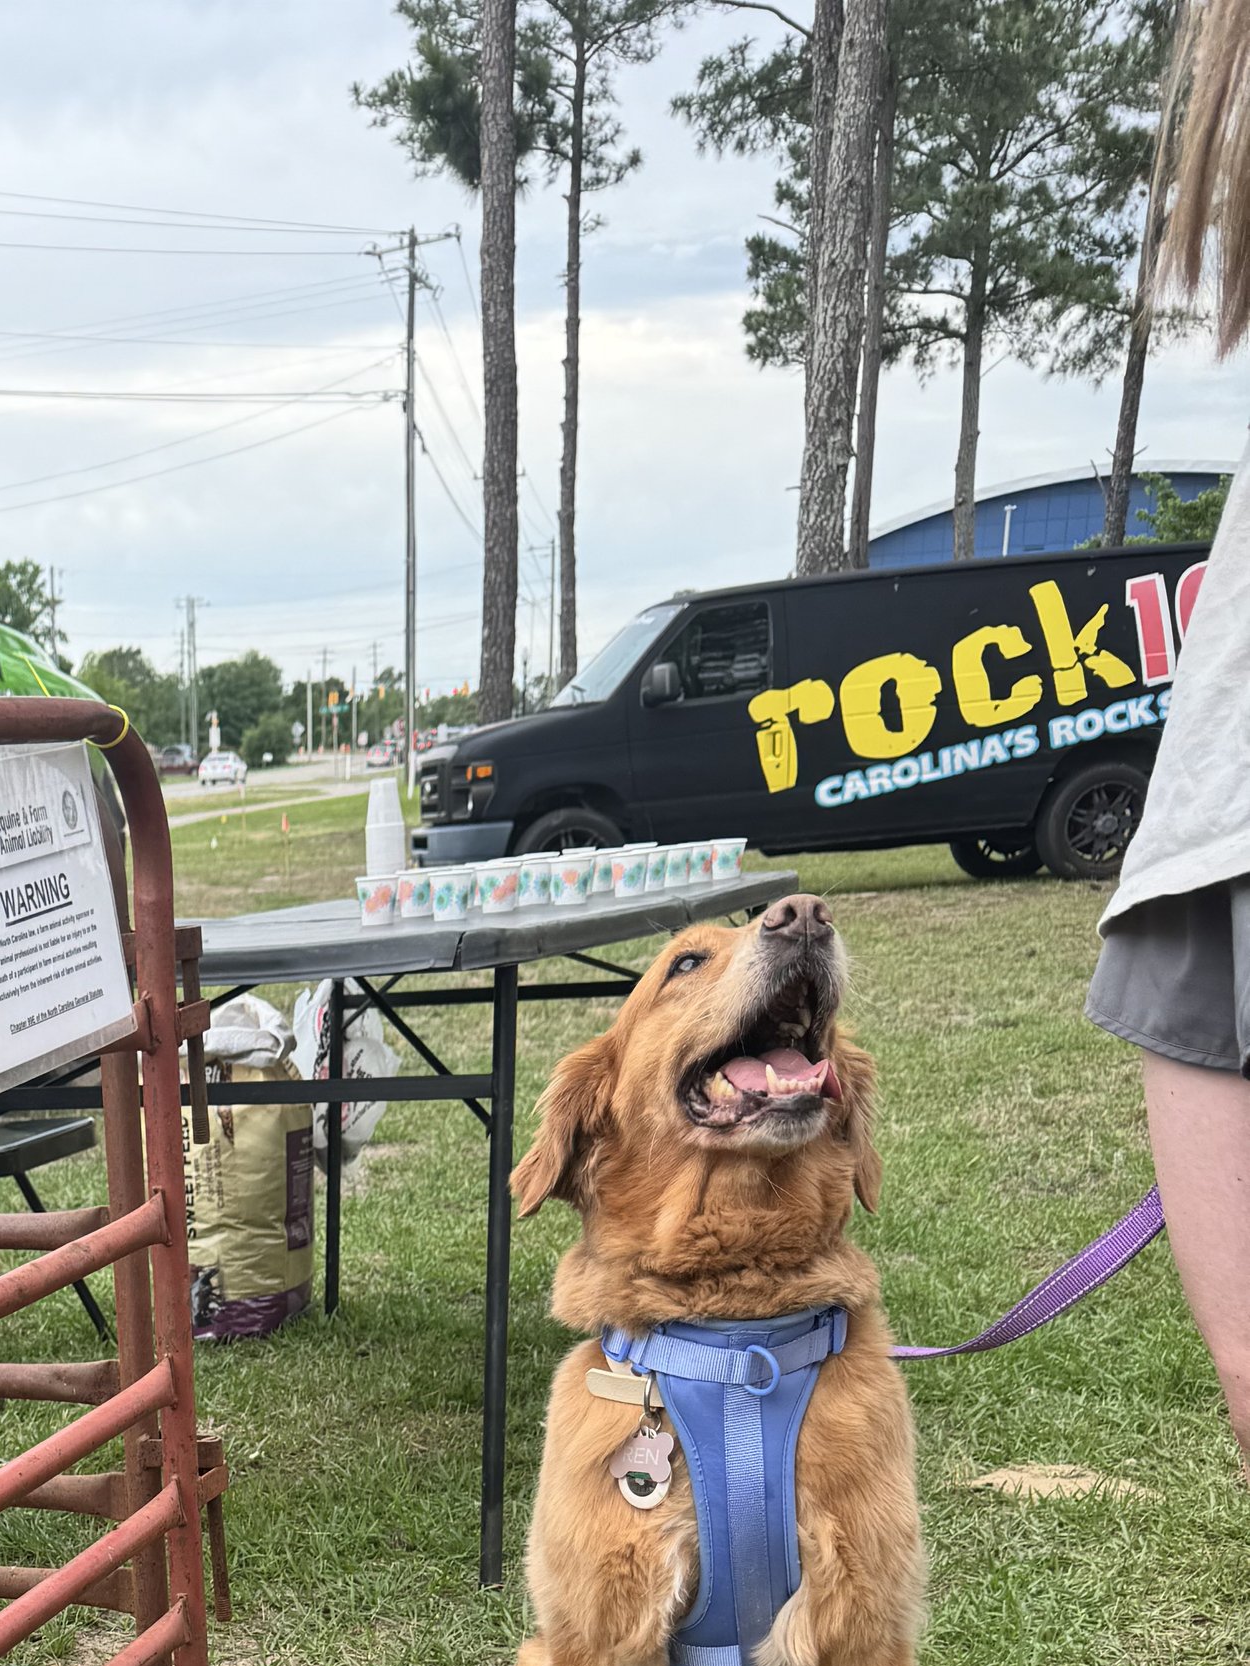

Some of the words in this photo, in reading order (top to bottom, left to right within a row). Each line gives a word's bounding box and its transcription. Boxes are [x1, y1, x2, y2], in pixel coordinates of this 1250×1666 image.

[748, 580, 1136, 793] rock
[815, 724, 1040, 807] CAROLINA'S
[22, 807, 29, 824] &
[29, 805, 48, 824] Farm
[0, 830, 26, 855] Animal
[26, 824, 54, 847] Liability
[0, 873, 70, 919] WARNING
[0, 937, 11, 948] North
[11, 931, 28, 943] Carolina
[39, 924, 49, 933] farm
[49, 918, 61, 930] animal
[62, 914, 75, 926] activity
[0, 953, 13, 966] animal
[14, 944, 38, 962] professional
[50, 937, 60, 947] liable
[72, 929, 82, 940] injury
[17, 963, 38, 978] participant
[42, 957, 51, 966] farm
[52, 951, 65, 963] animal
[66, 946, 81, 958] activities
[82, 940, 97, 951] resulting
[20, 982, 29, 993] from
[37, 974, 52, 986] inherent
[65, 966, 74, 975] farm
[75, 961, 86, 972] animal
[10, 1020, 27, 1033] Chapter
[47, 1006, 58, 1017] North
[58, 1000, 74, 1012] Carolina
[622, 1446, 660, 1466] REN
